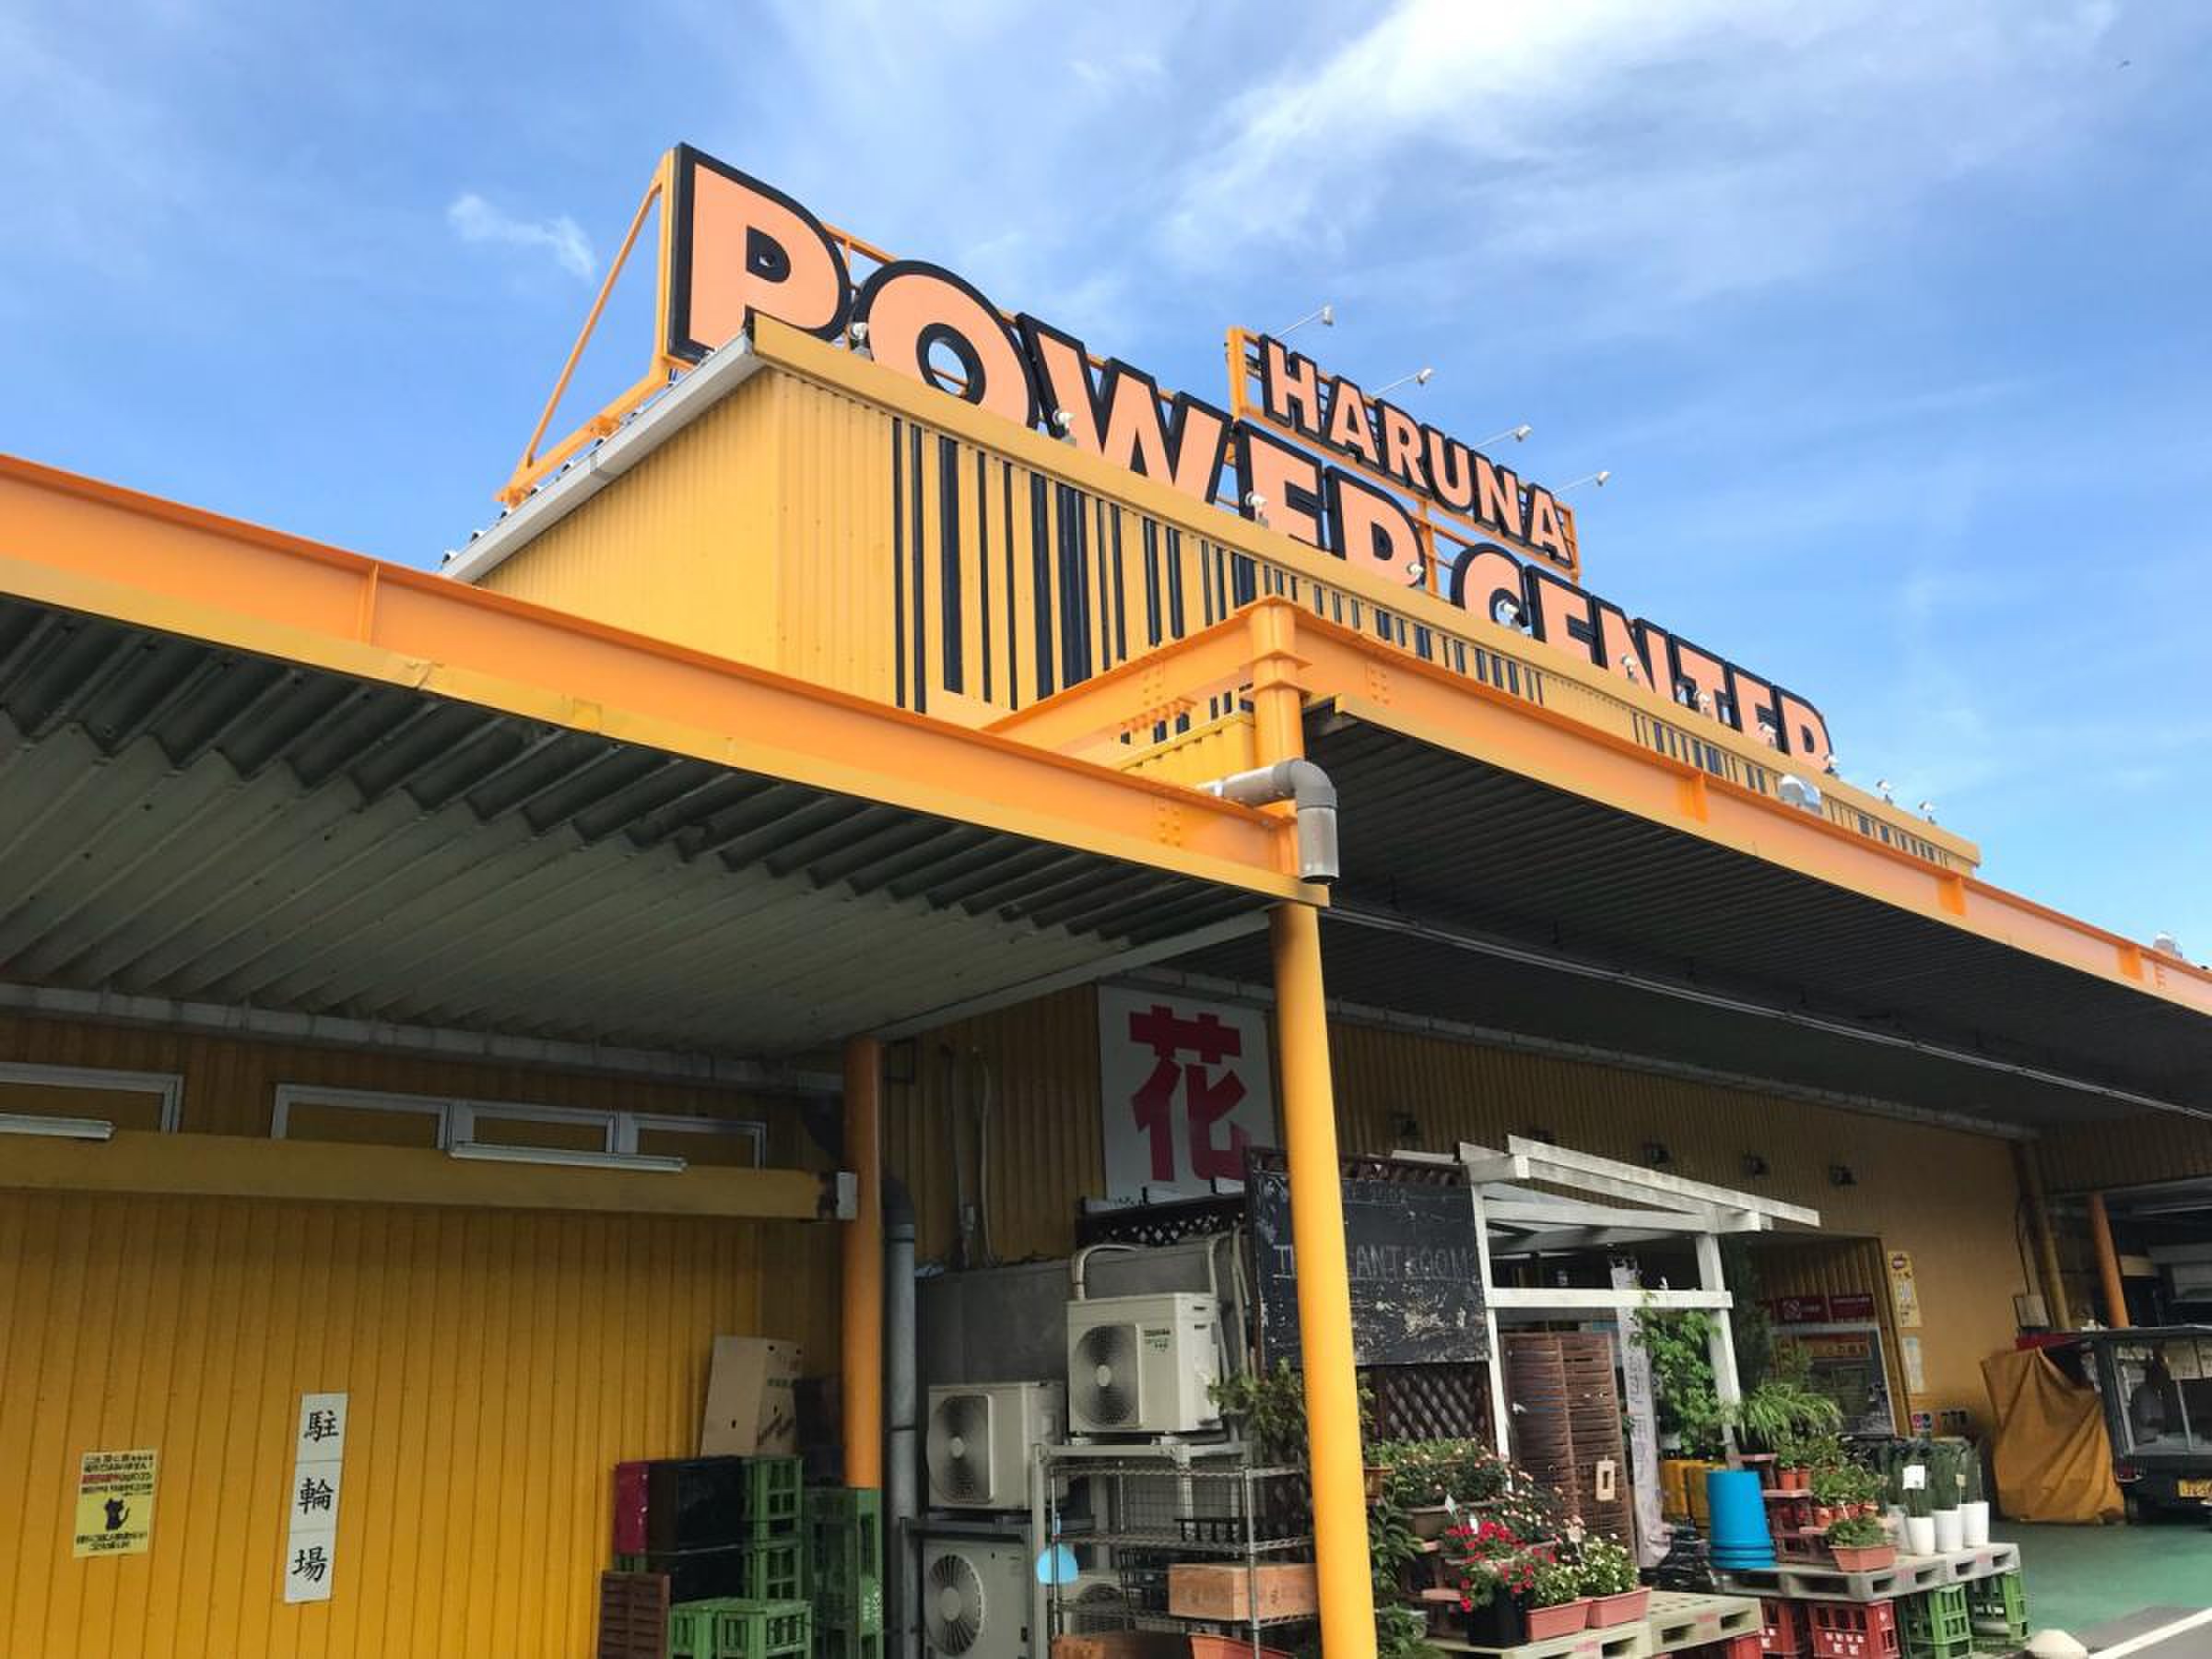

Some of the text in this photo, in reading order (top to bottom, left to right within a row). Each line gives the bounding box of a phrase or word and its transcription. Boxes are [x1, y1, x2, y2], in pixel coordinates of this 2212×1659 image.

[670, 143, 1834, 774] POWER CENTER
[1260, 334, 1574, 570] HARUNA
[1129, 1005, 1248, 1182] 花
[291, 1409, 339, 1583] 駐輪場
